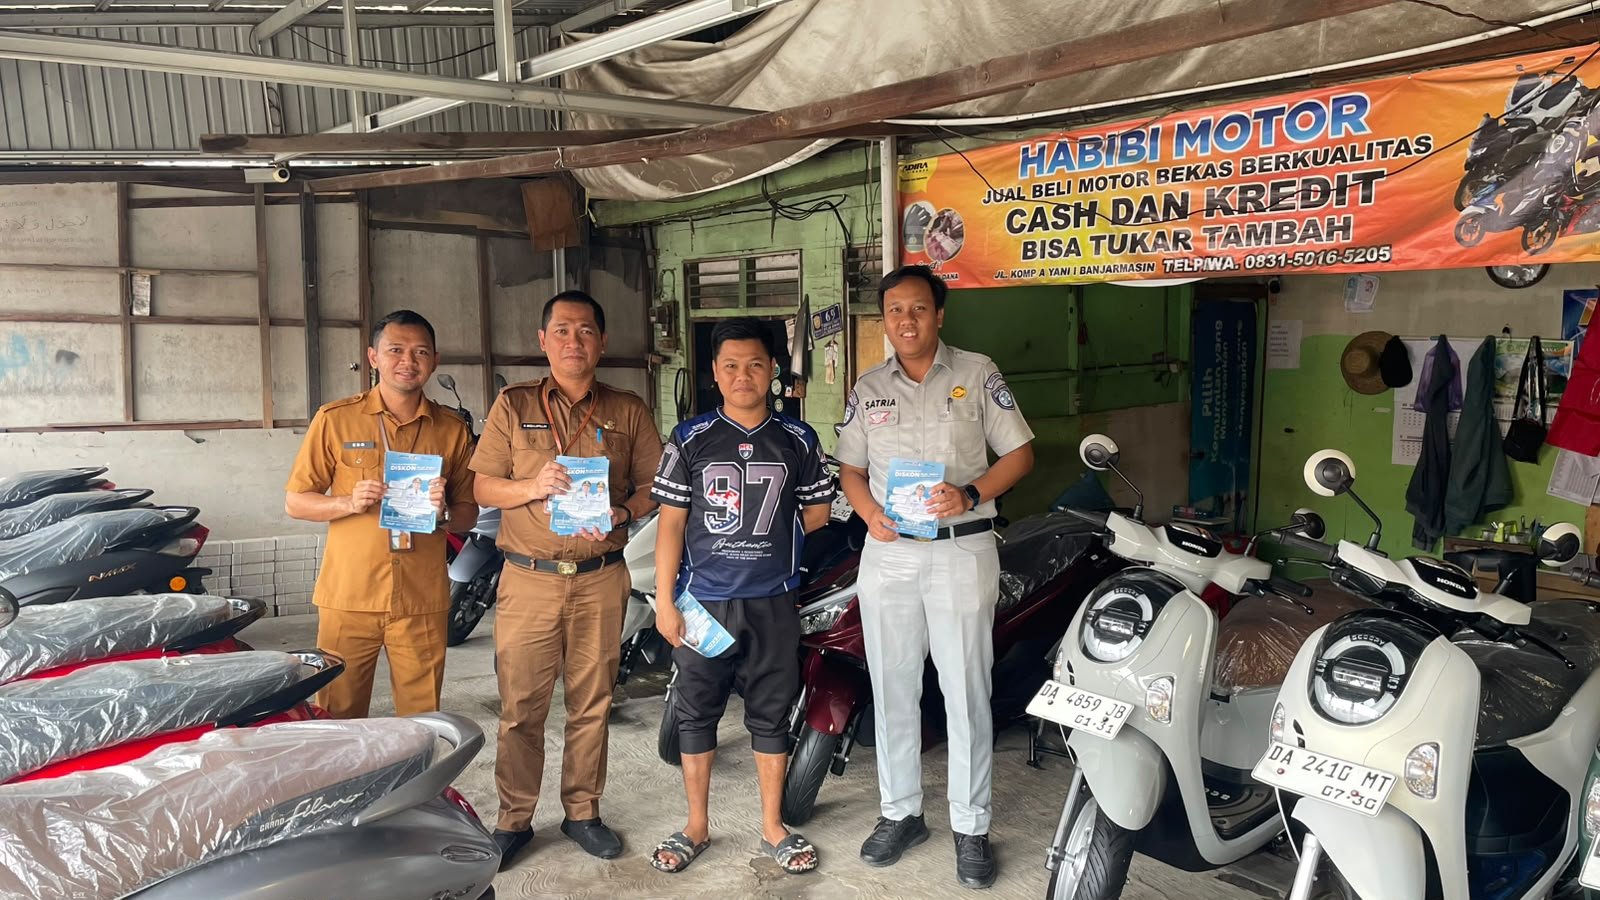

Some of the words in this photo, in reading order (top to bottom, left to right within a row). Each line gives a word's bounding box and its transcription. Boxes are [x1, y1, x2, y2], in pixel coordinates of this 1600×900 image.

[1019, 125, 1162, 180] HABIBI
[1173, 93, 1371, 160] MOTOR
[983, 187, 1026, 204] JUAL
[1032, 180, 1071, 199] BELI
[1078, 172, 1149, 193] MOTOR
[1157, 161, 1233, 184] BEKAS
[1241, 136, 1432, 175] BERKUALITAS
[1006, 201, 1098, 234] CASH
[1111, 191, 1190, 226] DAN
[1204, 170, 1386, 218] KREDIT
[1021, 237, 1081, 262] BISA
[1090, 229, 1193, 257] TUKAR
[1203, 215, 1353, 249] TAMBAH
[1245, 246, 1392, 270] 0831-5016-5205
[995, 271, 1008, 279] JL.
[1011, 269, 1036, 278] KOMP
[1039, 269, 1045, 277] A
[1049, 268, 1070, 276] YANI
[1080, 263, 1155, 275] BANJARMASIN
[825, 309, 836, 322] 69
[1202, 367, 1213, 416] Pilih
[865, 398, 896, 410] SATRIA
[702, 461, 789, 536] 97
[711, 537, 773, 549] Authentic
[1181, 541, 1208, 553] HONDA
[1436, 577, 1467, 592] HONDA
[1351, 633, 1385, 646] SCOOPY
[1040, 684, 1060, 699] DA
[1066, 692, 1102, 712] 4859
[1105, 704, 1126, 719] JB
[1268, 745, 1294, 765] DA
[1302, 755, 1353, 781] 2410
[1361, 771, 1392, 792] MT
[260, 817, 285, 832] GRAND
